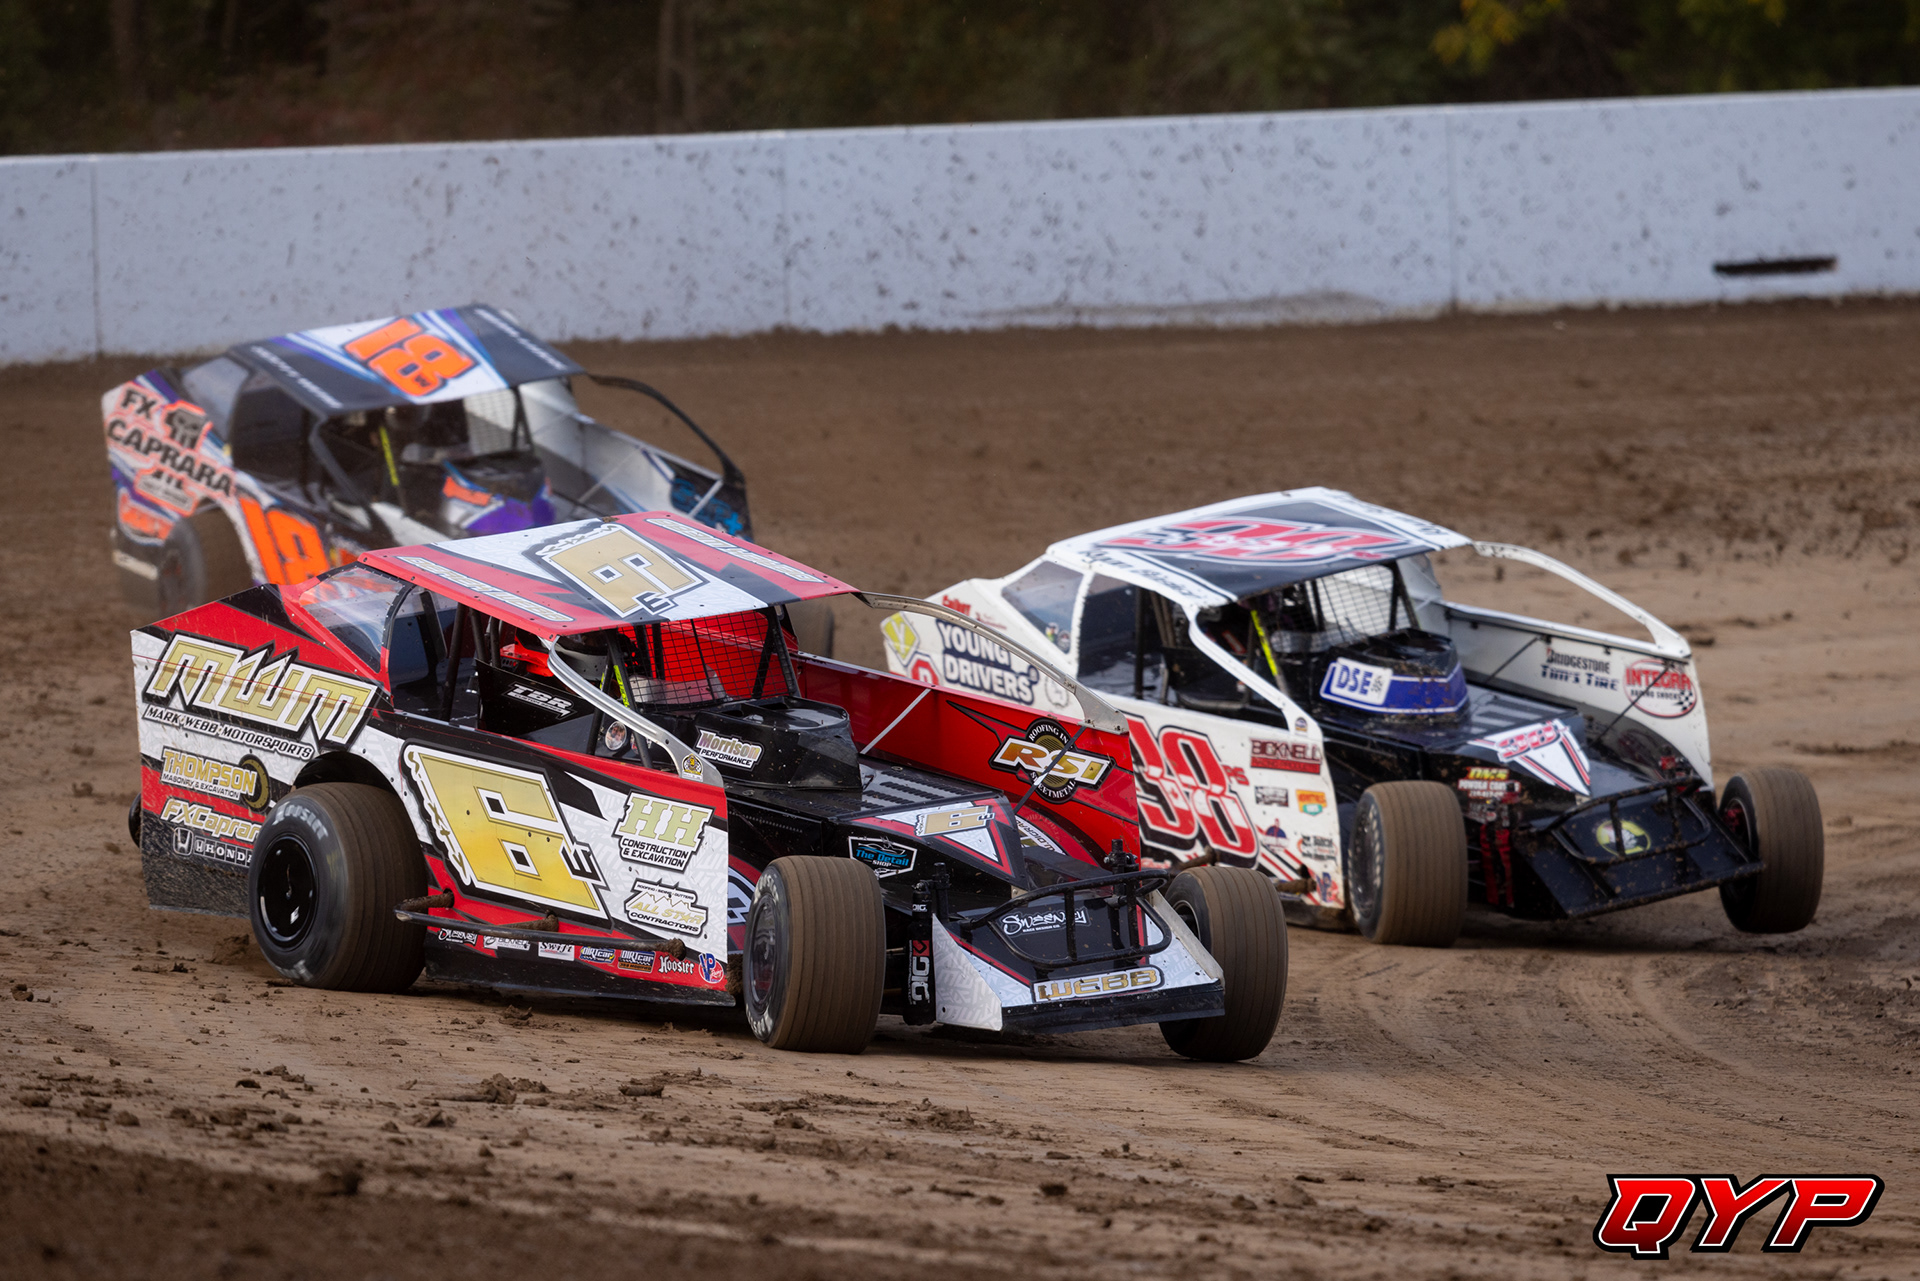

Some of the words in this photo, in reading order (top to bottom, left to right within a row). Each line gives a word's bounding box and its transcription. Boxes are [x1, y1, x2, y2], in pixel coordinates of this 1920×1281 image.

[343, 318, 475, 397] 18
[120, 389, 157, 419] FX
[107, 419, 234, 497] CAPRARA
[937, 621, 1010, 666] YOUNG
[1546, 648, 1611, 674] BRIDGESTONE
[146, 634, 377, 744] MWM
[944, 654, 1032, 704] DRIVERS
[1335, 664, 1373, 696] DSE
[1625, 668, 1692, 690] INTEGRA
[512, 683, 572, 709] TBR
[147, 706, 180, 726] MARK
[183, 715, 218, 733] WEBB
[221, 725, 313, 759] MOTORSPORTS
[699, 731, 761, 760] Morrison
[1028, 724, 1060, 742] ROOFING
[700, 748, 753, 766] PERFORMANCE
[1000, 741, 1106, 782] RSI
[163, 749, 257, 797] THOMPSON
[163, 773, 195, 790] MASONRY
[201, 782, 240, 799] EXCAVATION
[619, 796, 709, 848] HH
[205, 844, 252, 866] HOND
[621, 838, 689, 860] CONSTRUCTION
[631, 849, 685, 868] EXCAVATION
[855, 849, 875, 860] The
[877, 853, 909, 867] Detail
[872, 860, 892, 868] SHOP
[630, 911, 700, 933] CONTRACTORS
[631, 902, 659, 915] ALL
[658, 955, 695, 975] Hoosier
[698, 952, 716, 982] VP
[1037, 968, 1158, 1001] WEBB
